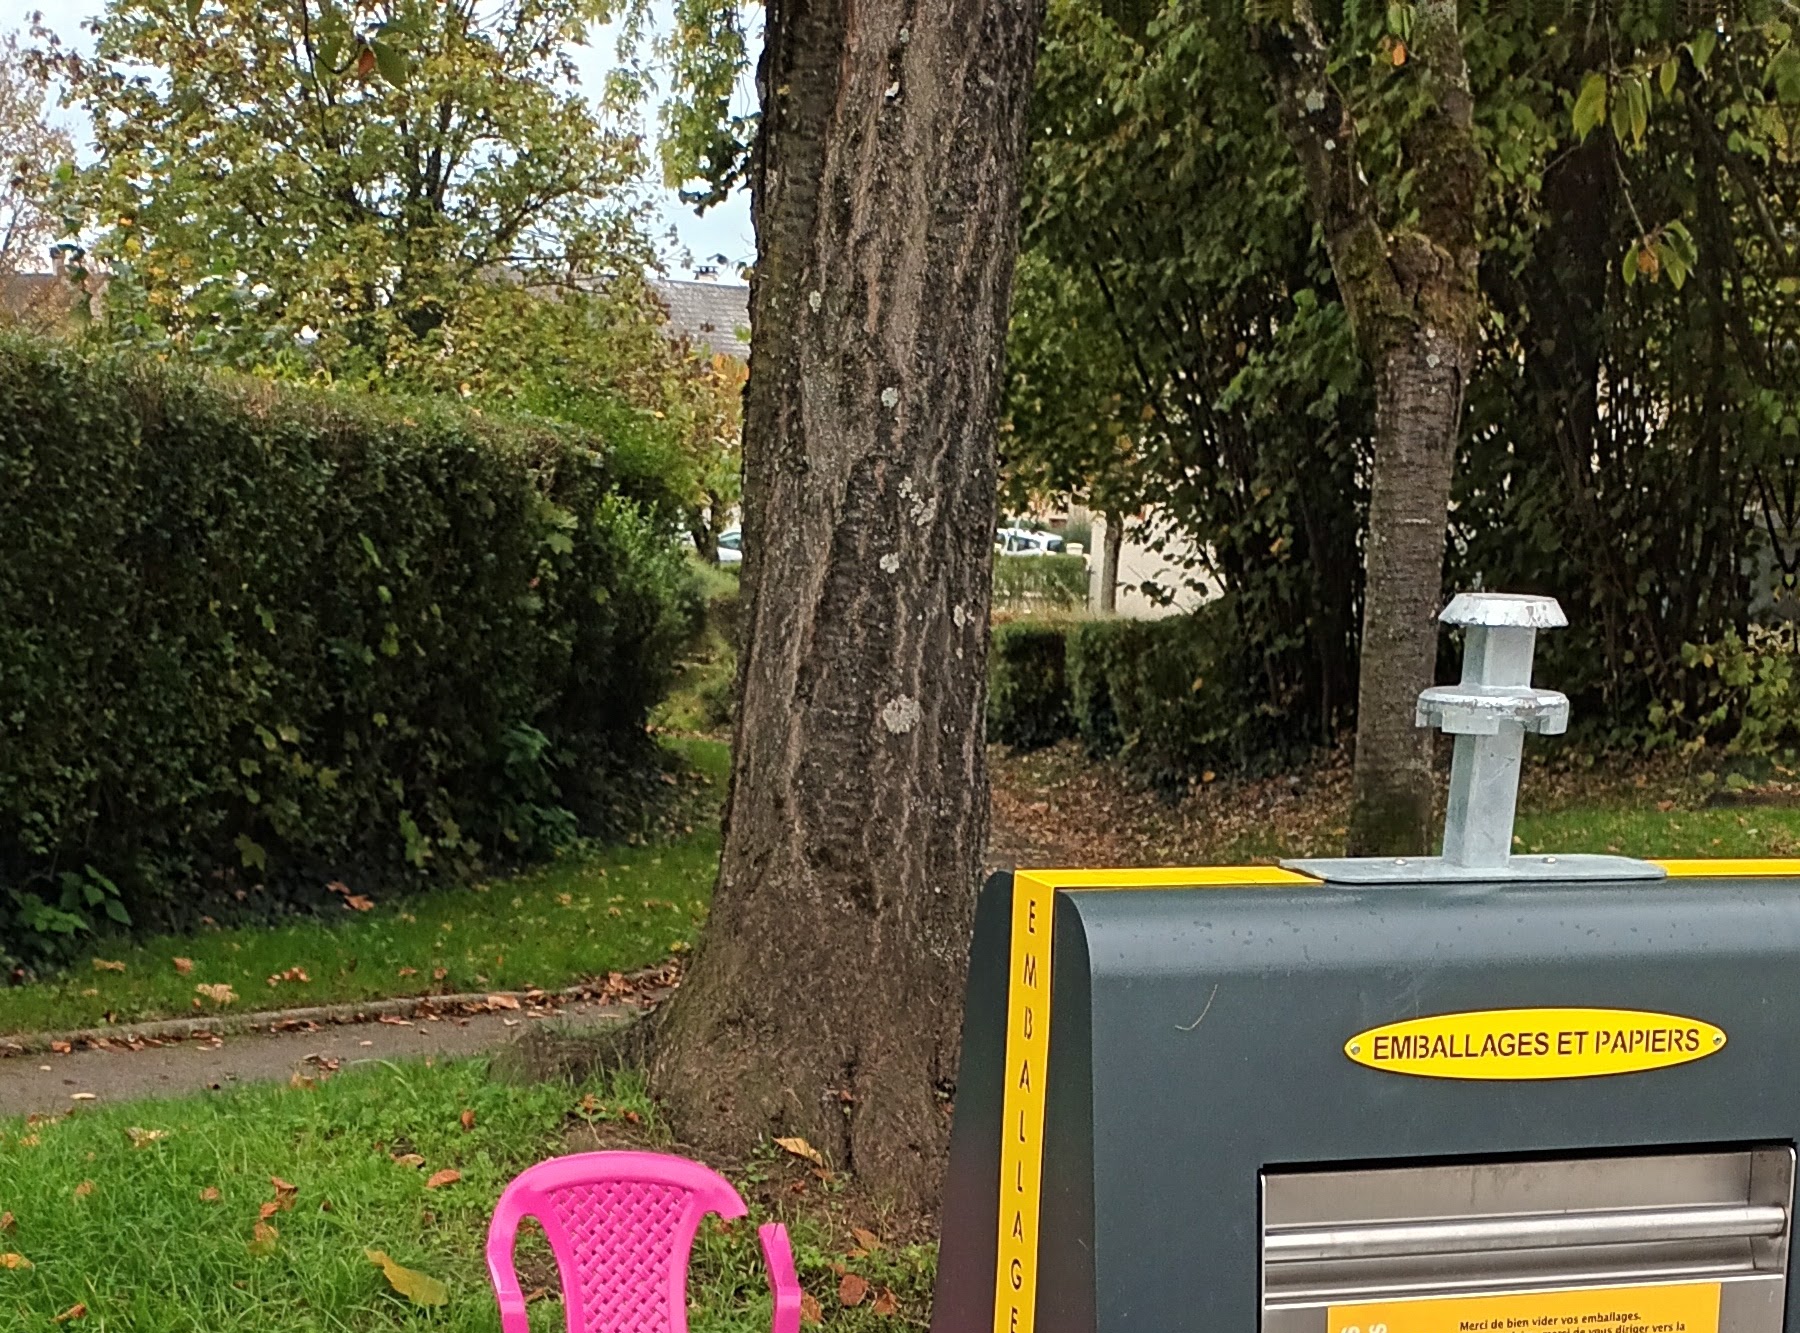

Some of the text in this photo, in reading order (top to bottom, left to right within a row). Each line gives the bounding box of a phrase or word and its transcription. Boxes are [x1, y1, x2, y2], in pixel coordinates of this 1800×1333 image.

[1374, 1029, 1701, 1060] EMBALLAGES ET PAPIERS
[1460, 1312, 1641, 1331] Merci de bien vider vos emballages.
[1652, 1323, 1673, 1333] vers
[1676, 1321, 1685, 1331] la
